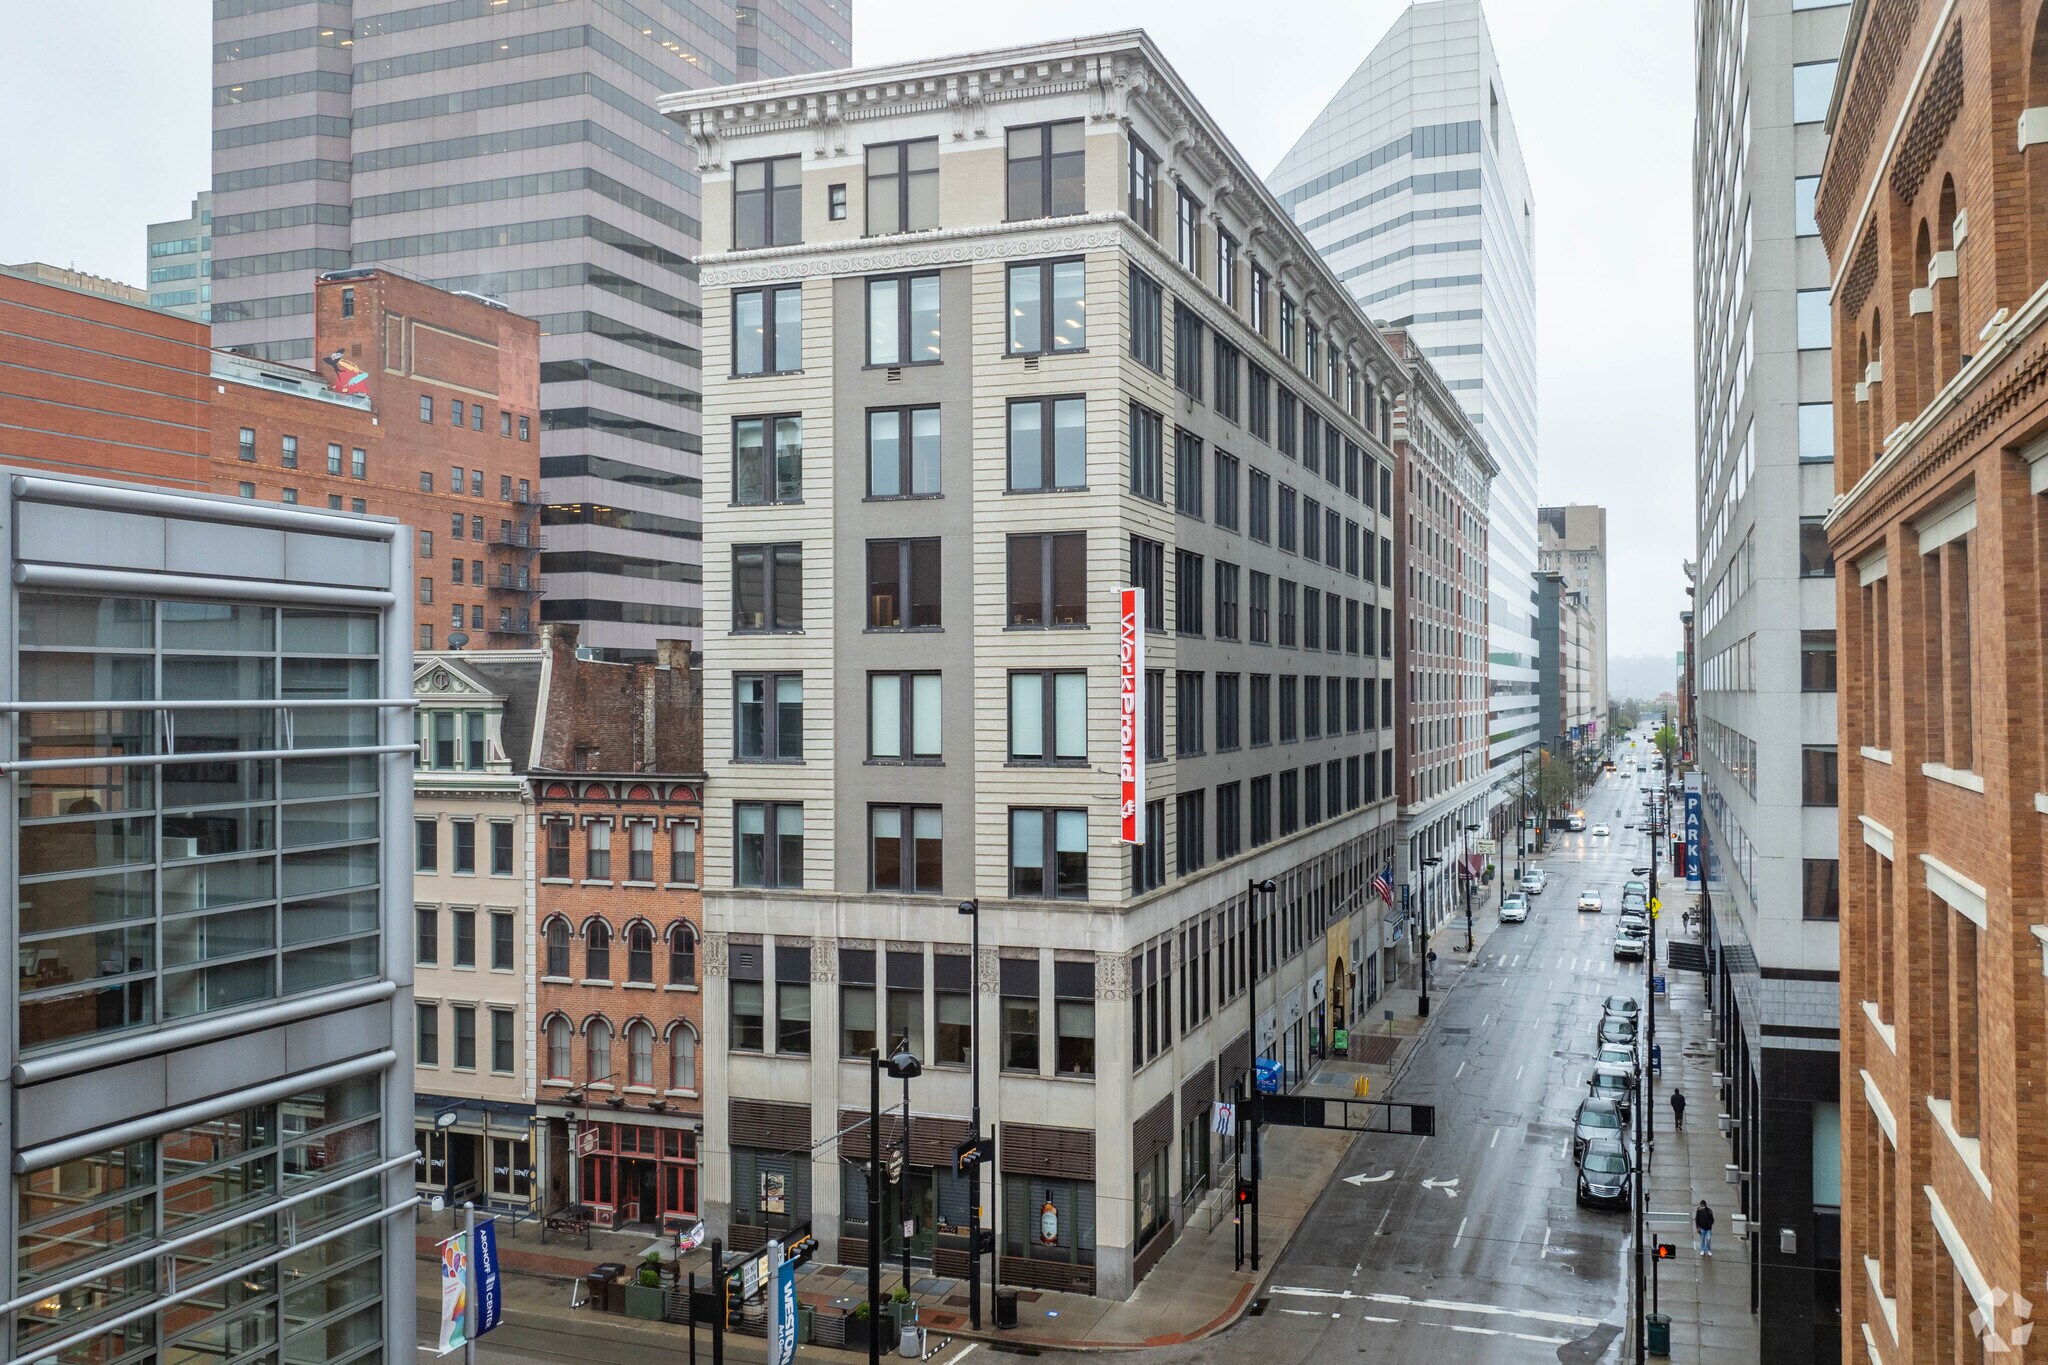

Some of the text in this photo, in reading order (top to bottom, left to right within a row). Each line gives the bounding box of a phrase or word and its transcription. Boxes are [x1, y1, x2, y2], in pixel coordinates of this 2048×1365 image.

[1121, 612, 1135, 782] WorkProud
[1687, 799, 1698, 856] PARK
[479, 1229, 491, 1273] ARONOFF
[484, 1293, 494, 1330] CENTER
[784, 1280, 794, 1365] WESTON
